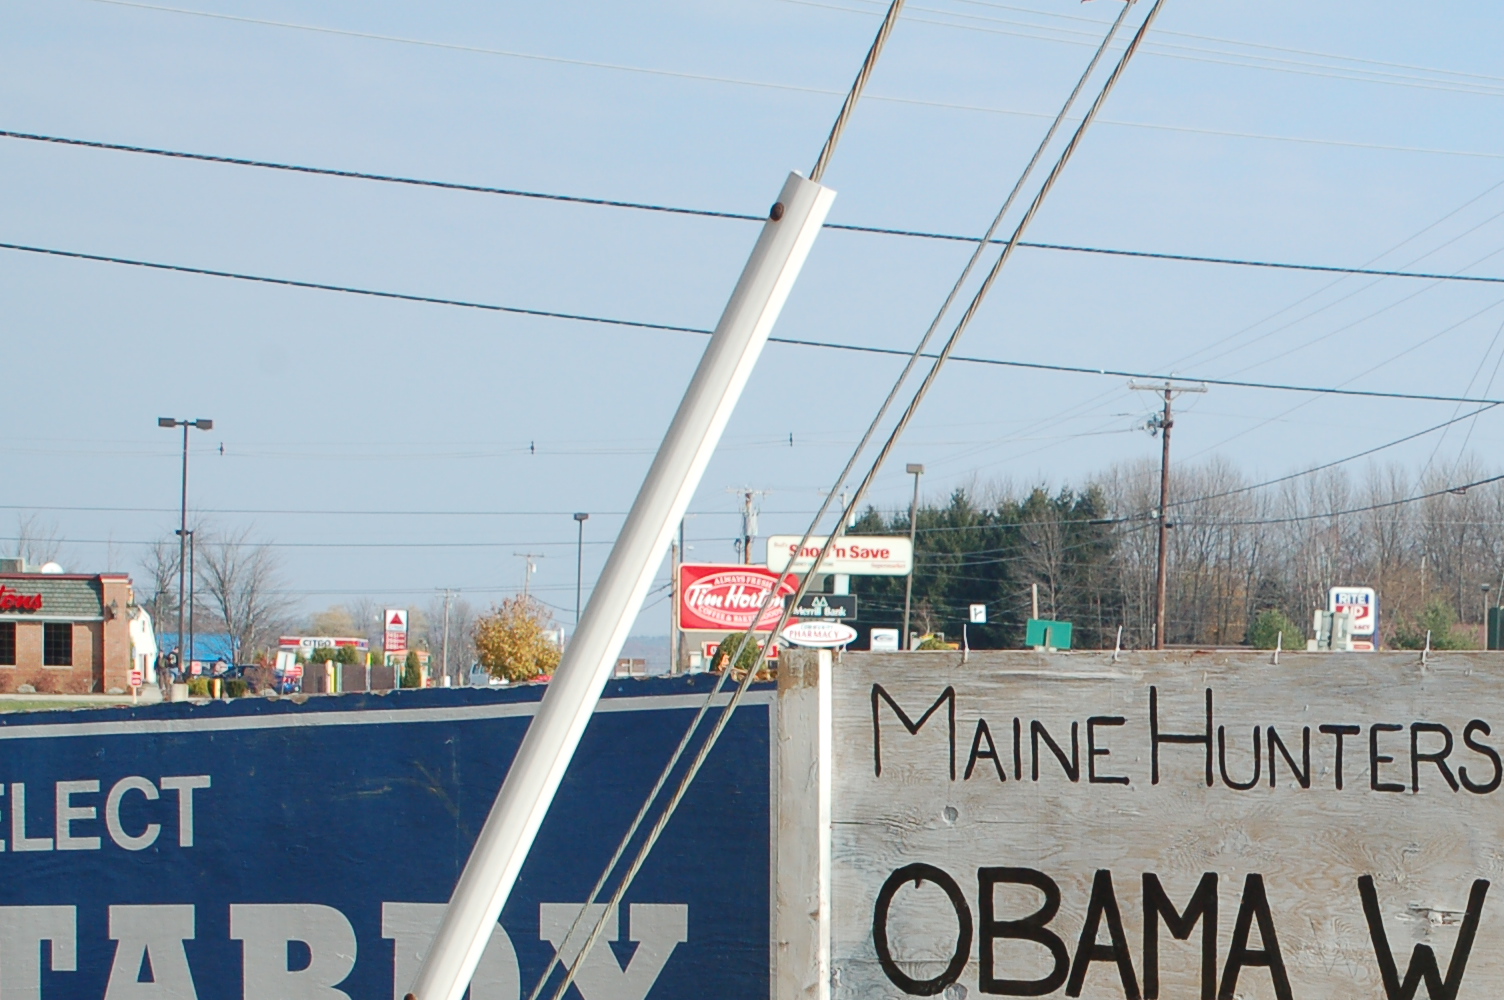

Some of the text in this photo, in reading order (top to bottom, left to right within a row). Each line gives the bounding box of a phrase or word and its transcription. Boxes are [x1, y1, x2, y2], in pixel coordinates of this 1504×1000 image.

[850, 545, 890, 559] Save
[689, 583, 724, 608] Tim
[1339, 593, 1366, 604] RITE
[793, 606, 821, 616] Merrill
[824, 606, 847, 616] Bank
[789, 630, 839, 638] PHARMACY
[303, 639, 331, 647] CITGO
[871, 684, 1129, 785] MAINE
[1150, 686, 1503, 795] HUNTERS
[0, 775, 211, 851] LECT
